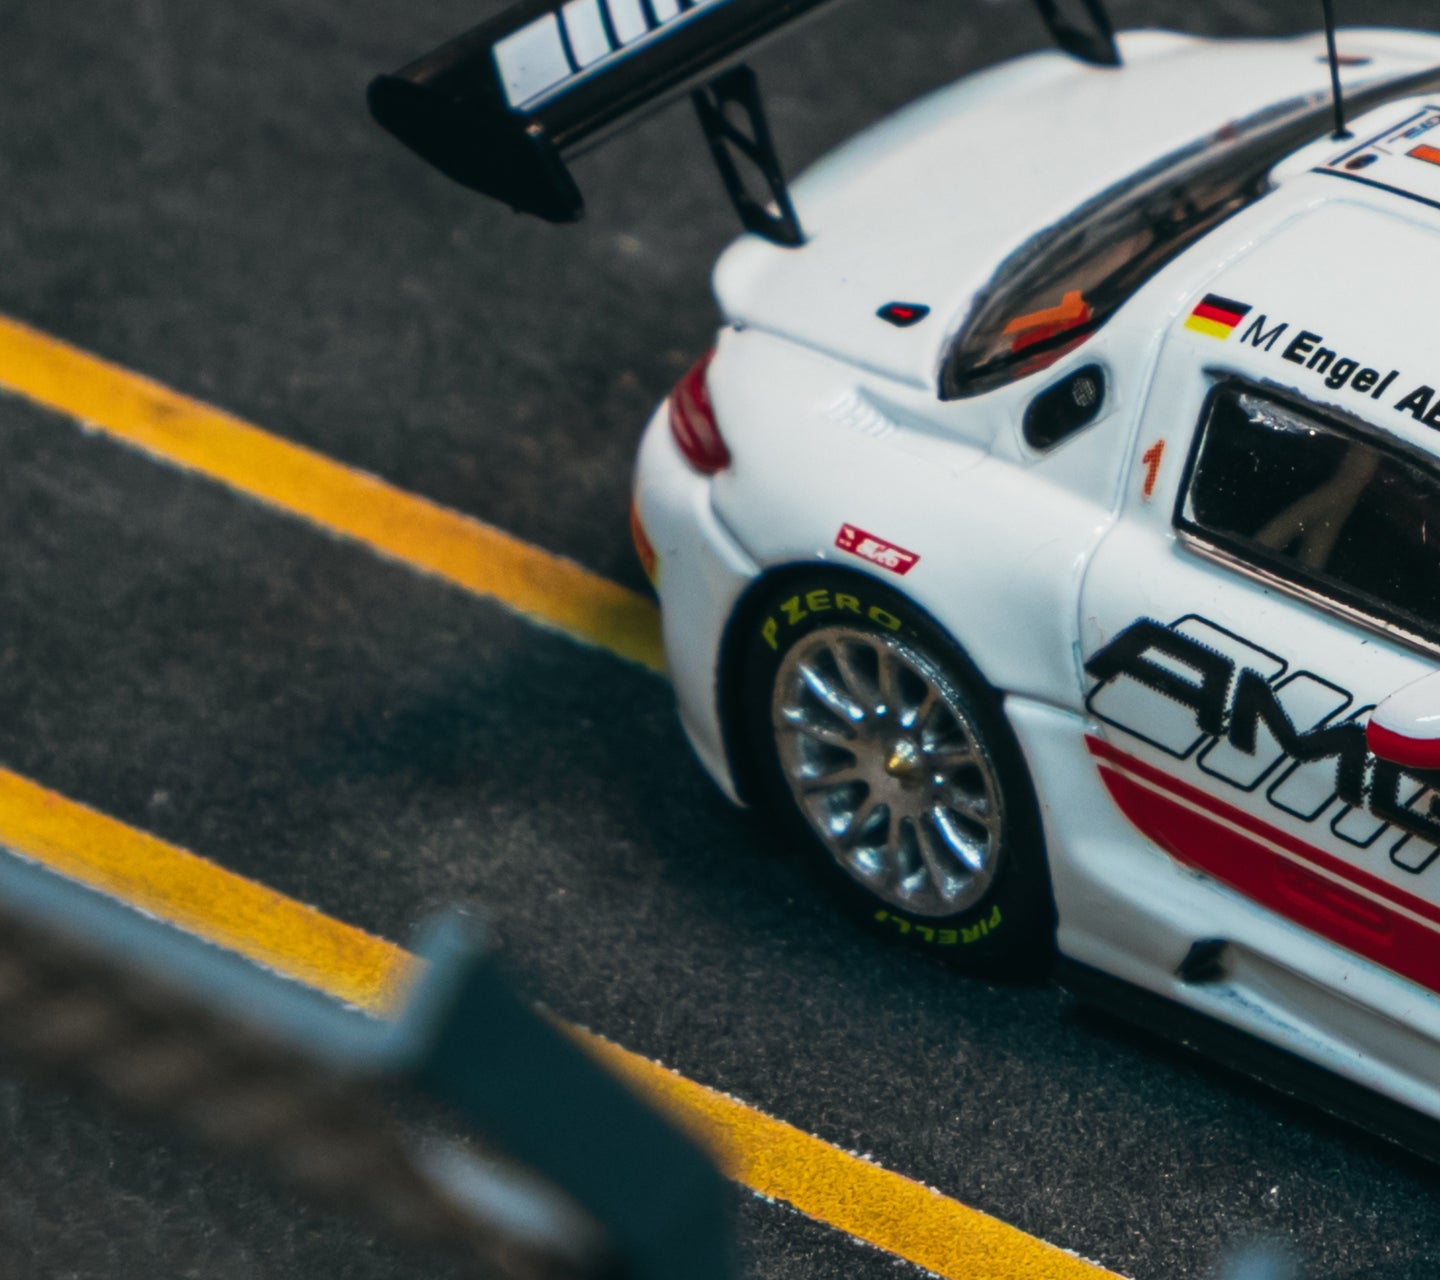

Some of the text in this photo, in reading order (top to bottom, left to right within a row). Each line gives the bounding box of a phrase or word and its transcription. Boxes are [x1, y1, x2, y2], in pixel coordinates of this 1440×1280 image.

[1239, 314, 1290, 352] M
[1280, 329, 1400, 400] Engel
[1141, 439, 1166, 500] 1
